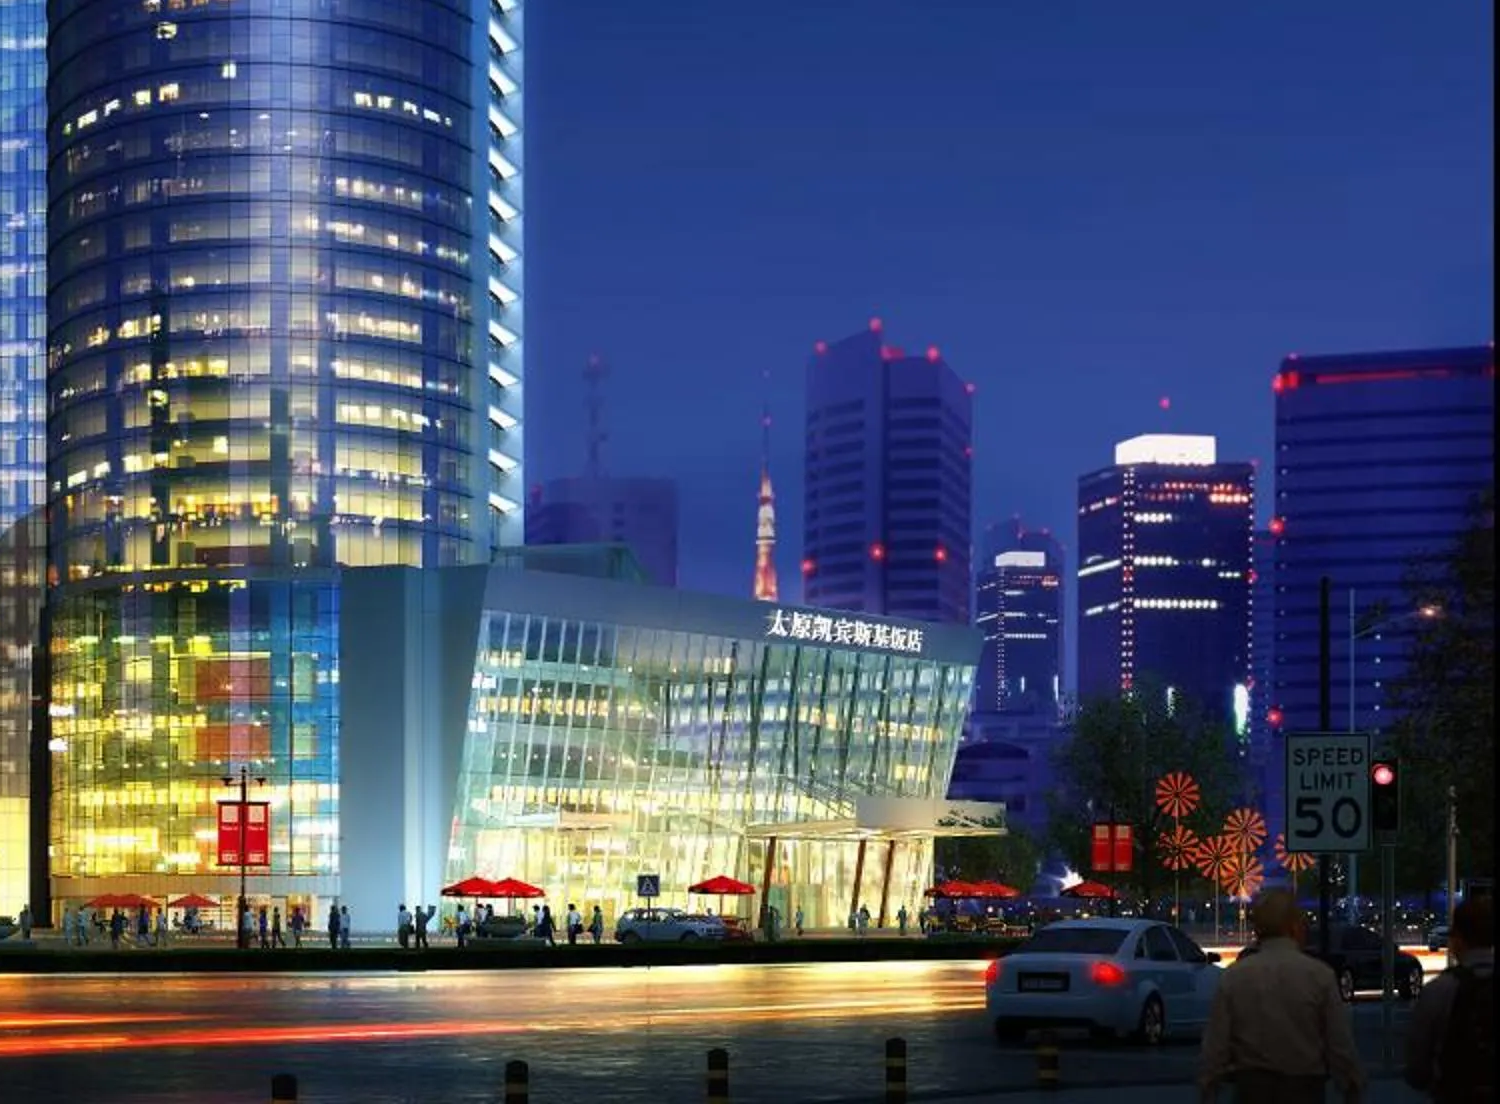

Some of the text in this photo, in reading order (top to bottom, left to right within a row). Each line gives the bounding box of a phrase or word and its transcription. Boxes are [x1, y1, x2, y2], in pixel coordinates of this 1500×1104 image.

[767, 609, 924, 653] 太原凯宾斯基饭店
[1293, 747, 1364, 766] SPEED
[1300, 772, 1356, 791] LIMIT
[1294, 797, 1361, 838] 50
